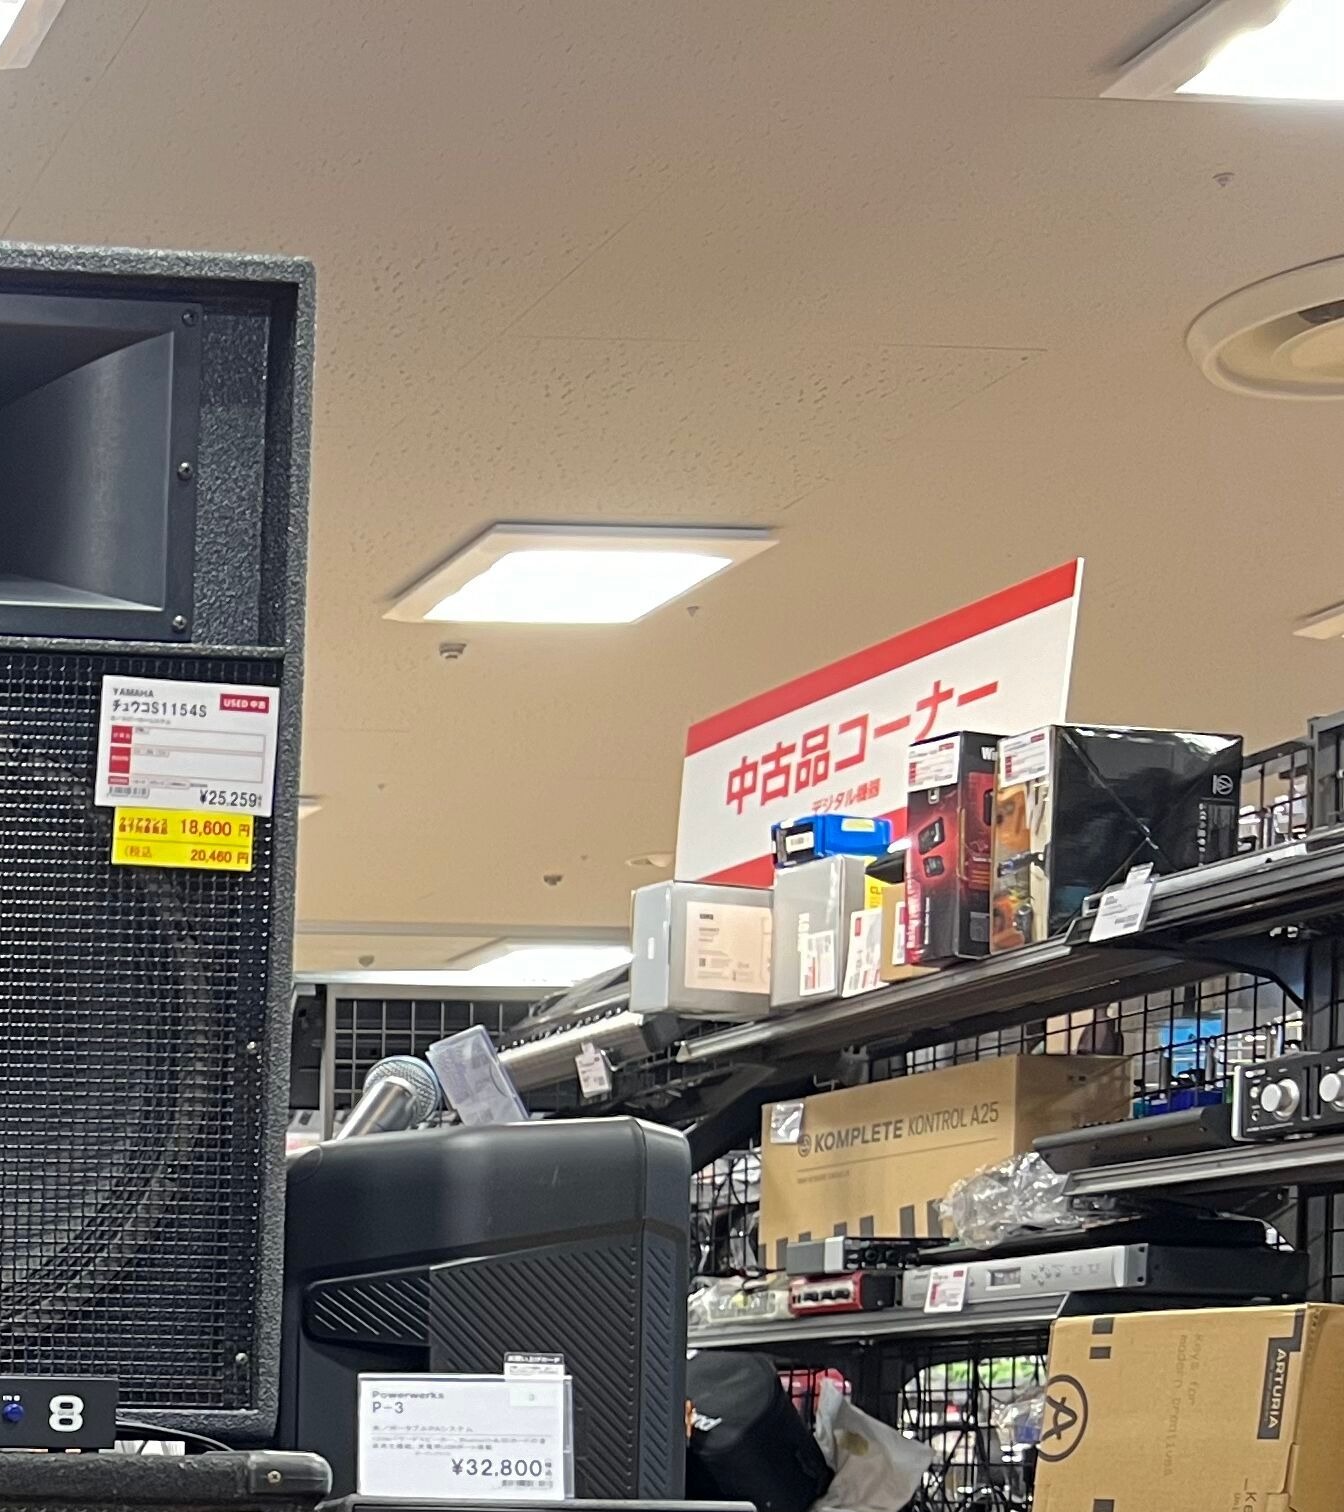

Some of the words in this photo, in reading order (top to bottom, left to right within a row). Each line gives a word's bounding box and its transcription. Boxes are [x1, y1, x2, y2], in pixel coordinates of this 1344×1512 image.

[113, 688, 154, 698] YAMAHA
[223, 698, 249, 709] USED
[250, 699, 266, 710] 中古
[726, 680, 1000, 816] 中古品コーナー
[199, 789, 257, 808] ¥25,259
[180, 819, 232, 837] 18,600
[238, 824, 250, 838] 円
[191, 849, 232, 864] 20,460
[237, 853, 249, 865] 円
[814, 1119, 904, 1154] KOMPLETE
[907, 1108, 968, 1138] KONTROL
[970, 1102, 999, 1126] A25
[1267, 1348, 1288, 1429] ARTURIA
[48, 1394, 84, 1433] 8
[372, 1401, 404, 1414] P-3
[451, 1457, 542, 1477] ¥32,800
